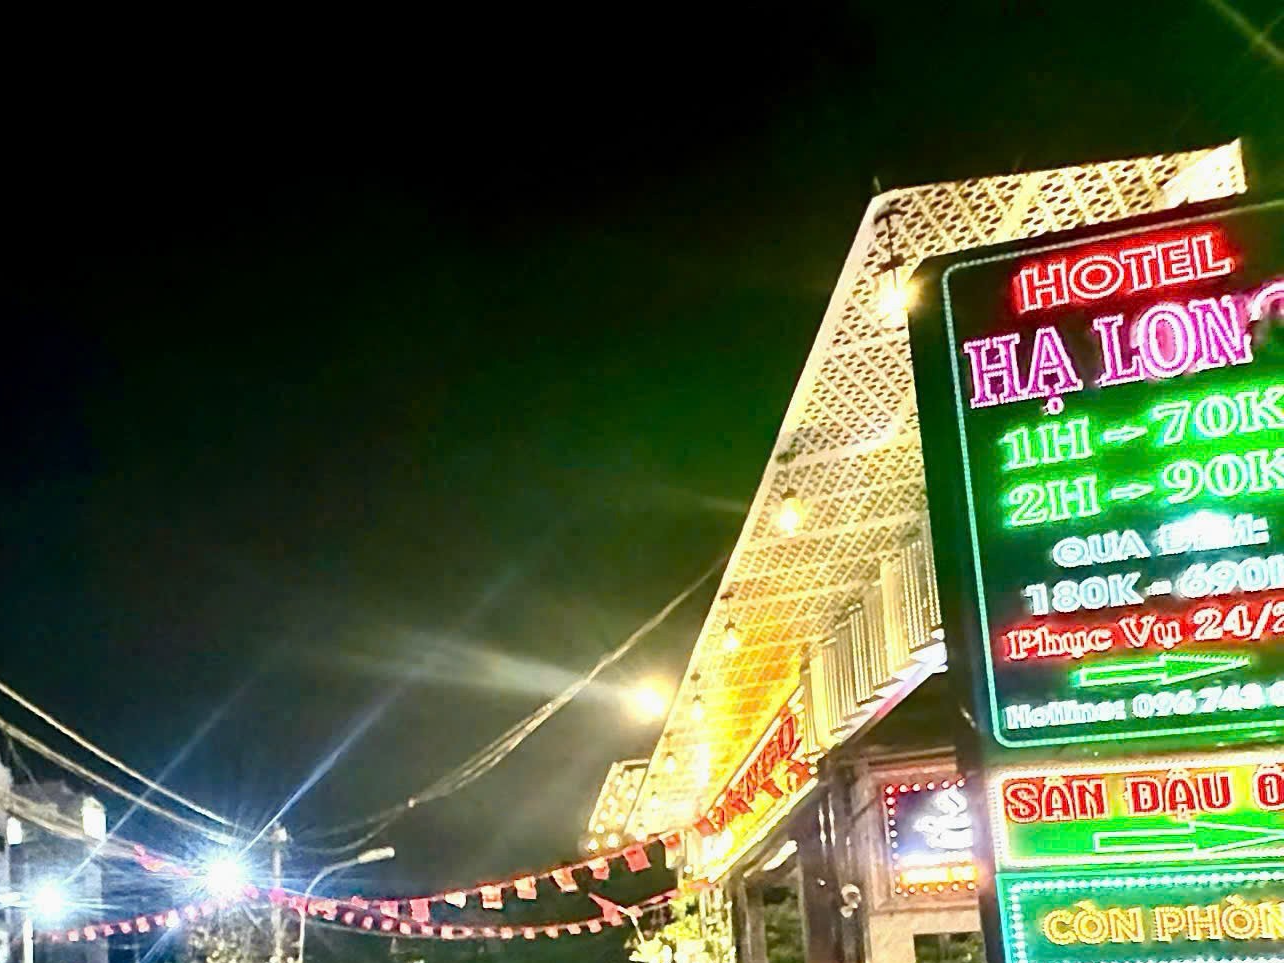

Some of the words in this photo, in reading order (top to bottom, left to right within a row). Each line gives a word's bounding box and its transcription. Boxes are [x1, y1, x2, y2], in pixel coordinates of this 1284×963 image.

[1020, 234, 1233, 312] HOTEL
[964, 326, 1083, 415] HẠ
[1001, 417, 1094, 470] 1H
[1152, 386, 1284, 445] 70K
[1005, 474, 1102, 527] 2H
[1162, 448, 1284, 504] 90K
[1051, 528, 1151, 568] QUA
[1025, 572, 1145, 616] 180K
[1117, 614, 1184, 650] Vụ
[1005, 775, 1109, 825] SÂN
[1121, 767, 1232, 822] ĐẬU
[1042, 899, 1145, 945] CÒN
